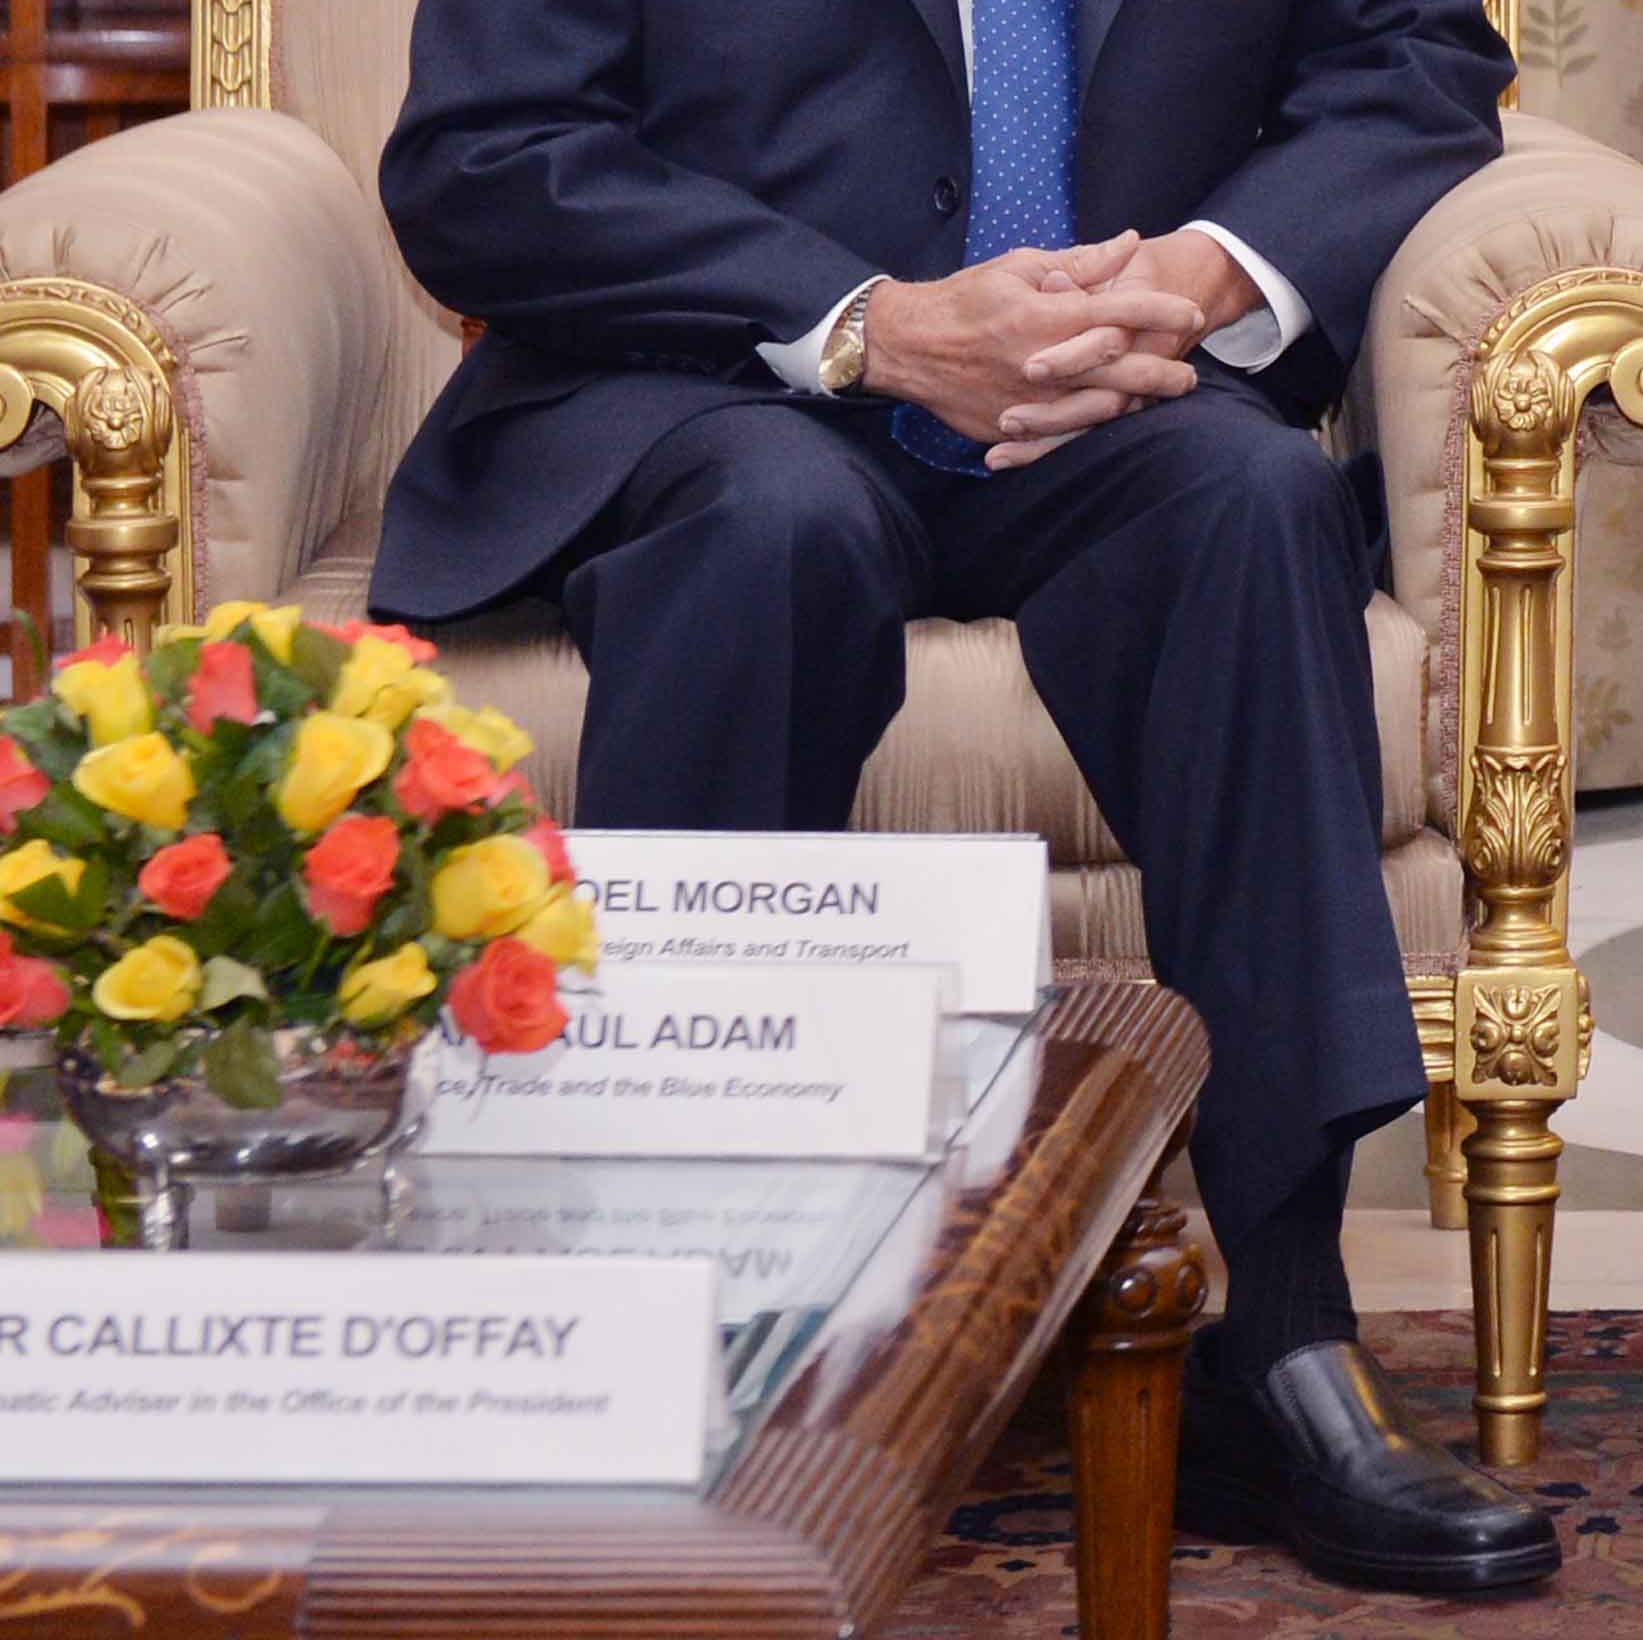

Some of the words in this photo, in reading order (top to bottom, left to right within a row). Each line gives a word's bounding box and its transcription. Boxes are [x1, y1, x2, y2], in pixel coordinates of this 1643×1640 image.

[674, 880, 878, 915] MORGAN
[659, 938, 736, 956] Affairs
[742, 941, 788, 957] and
[797, 940, 909, 963] Transport
[650, 1015, 796, 1050] ADAM
[480, 1074, 552, 1097] Trade
[557, 1077, 609, 1096] and
[613, 1078, 653, 1097] the
[658, 1076, 717, 1098] Blue
[722, 1077, 845, 1104] Economy
[0, 1314, 29, 1355] R
[46, 1314, 323, 1357] CALLIXTE
[341, 1316, 578, 1359] D'OFFAY
[66, 1389, 181, 1413] Adviser
[187, 1392, 218, 1413] in
[224, 1390, 274, 1413] the
[280, 1388, 368, 1414] Office
[374, 1392, 408, 1415] of
[412, 1392, 460, 1414] the
[466, 1389, 611, 1416] President
